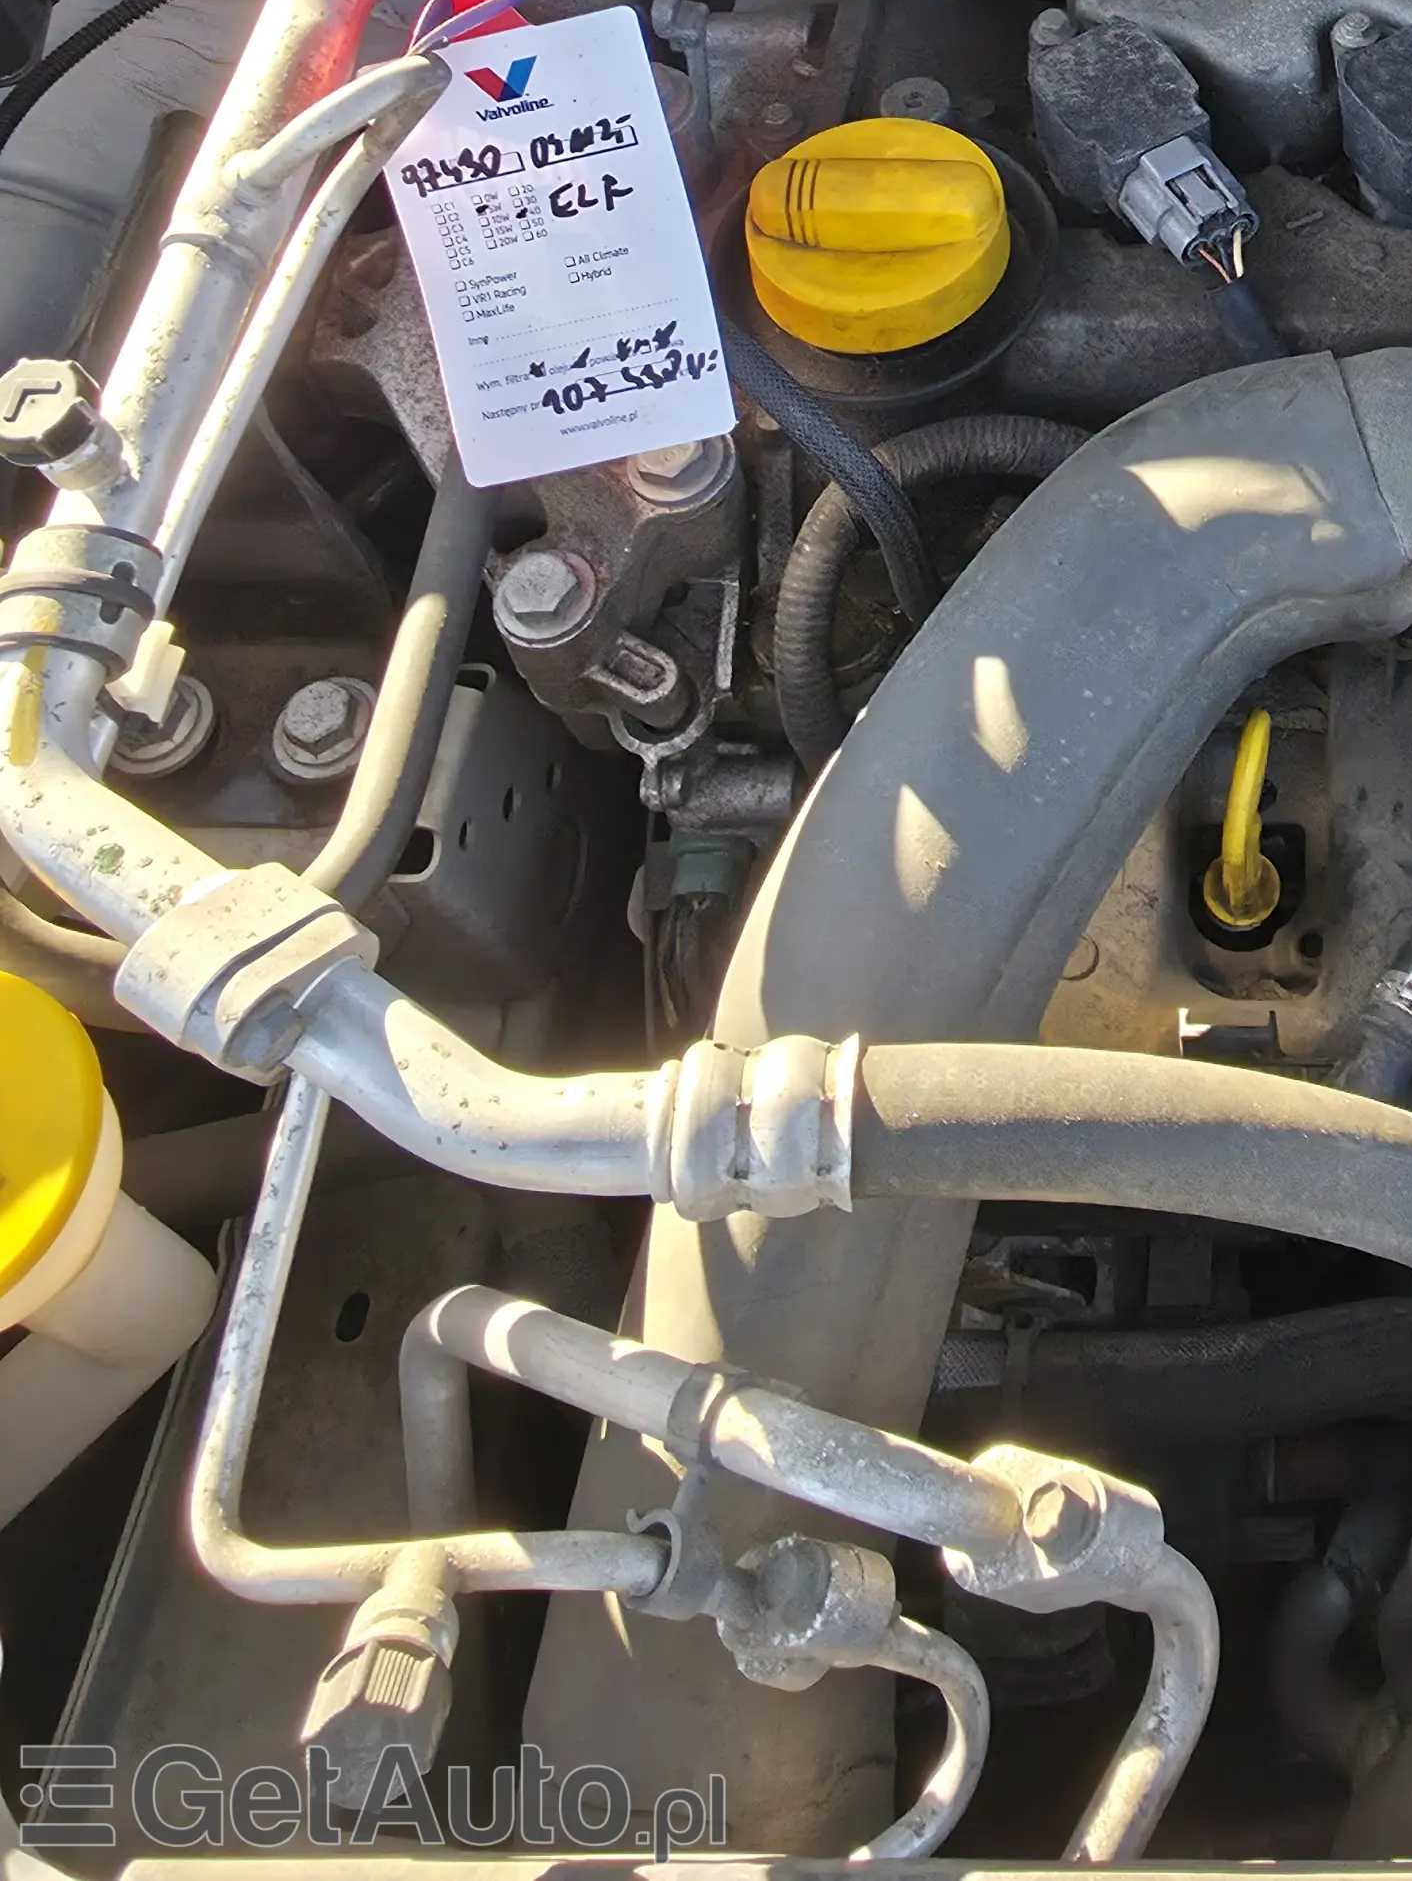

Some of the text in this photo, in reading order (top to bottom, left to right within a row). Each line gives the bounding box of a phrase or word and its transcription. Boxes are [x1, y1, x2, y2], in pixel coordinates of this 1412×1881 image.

[475, 96, 553, 122] Valvoline
[521, 184, 534, 194] 20
[444, 202, 455, 212] C1
[449, 212, 460, 222] C2
[532, 218, 544, 227] 50
[536, 228, 548, 239] 60
[455, 235, 468, 245] C4
[459, 246, 471, 256] C5
[593, 246, 629, 263] Climate
[462, 257, 475, 267] C6
[580, 267, 612, 282] Hybrid
[468, 272, 518, 290] SynPower
[494, 285, 527, 300] Racing
[475, 303, 516, 319] MaxLife
